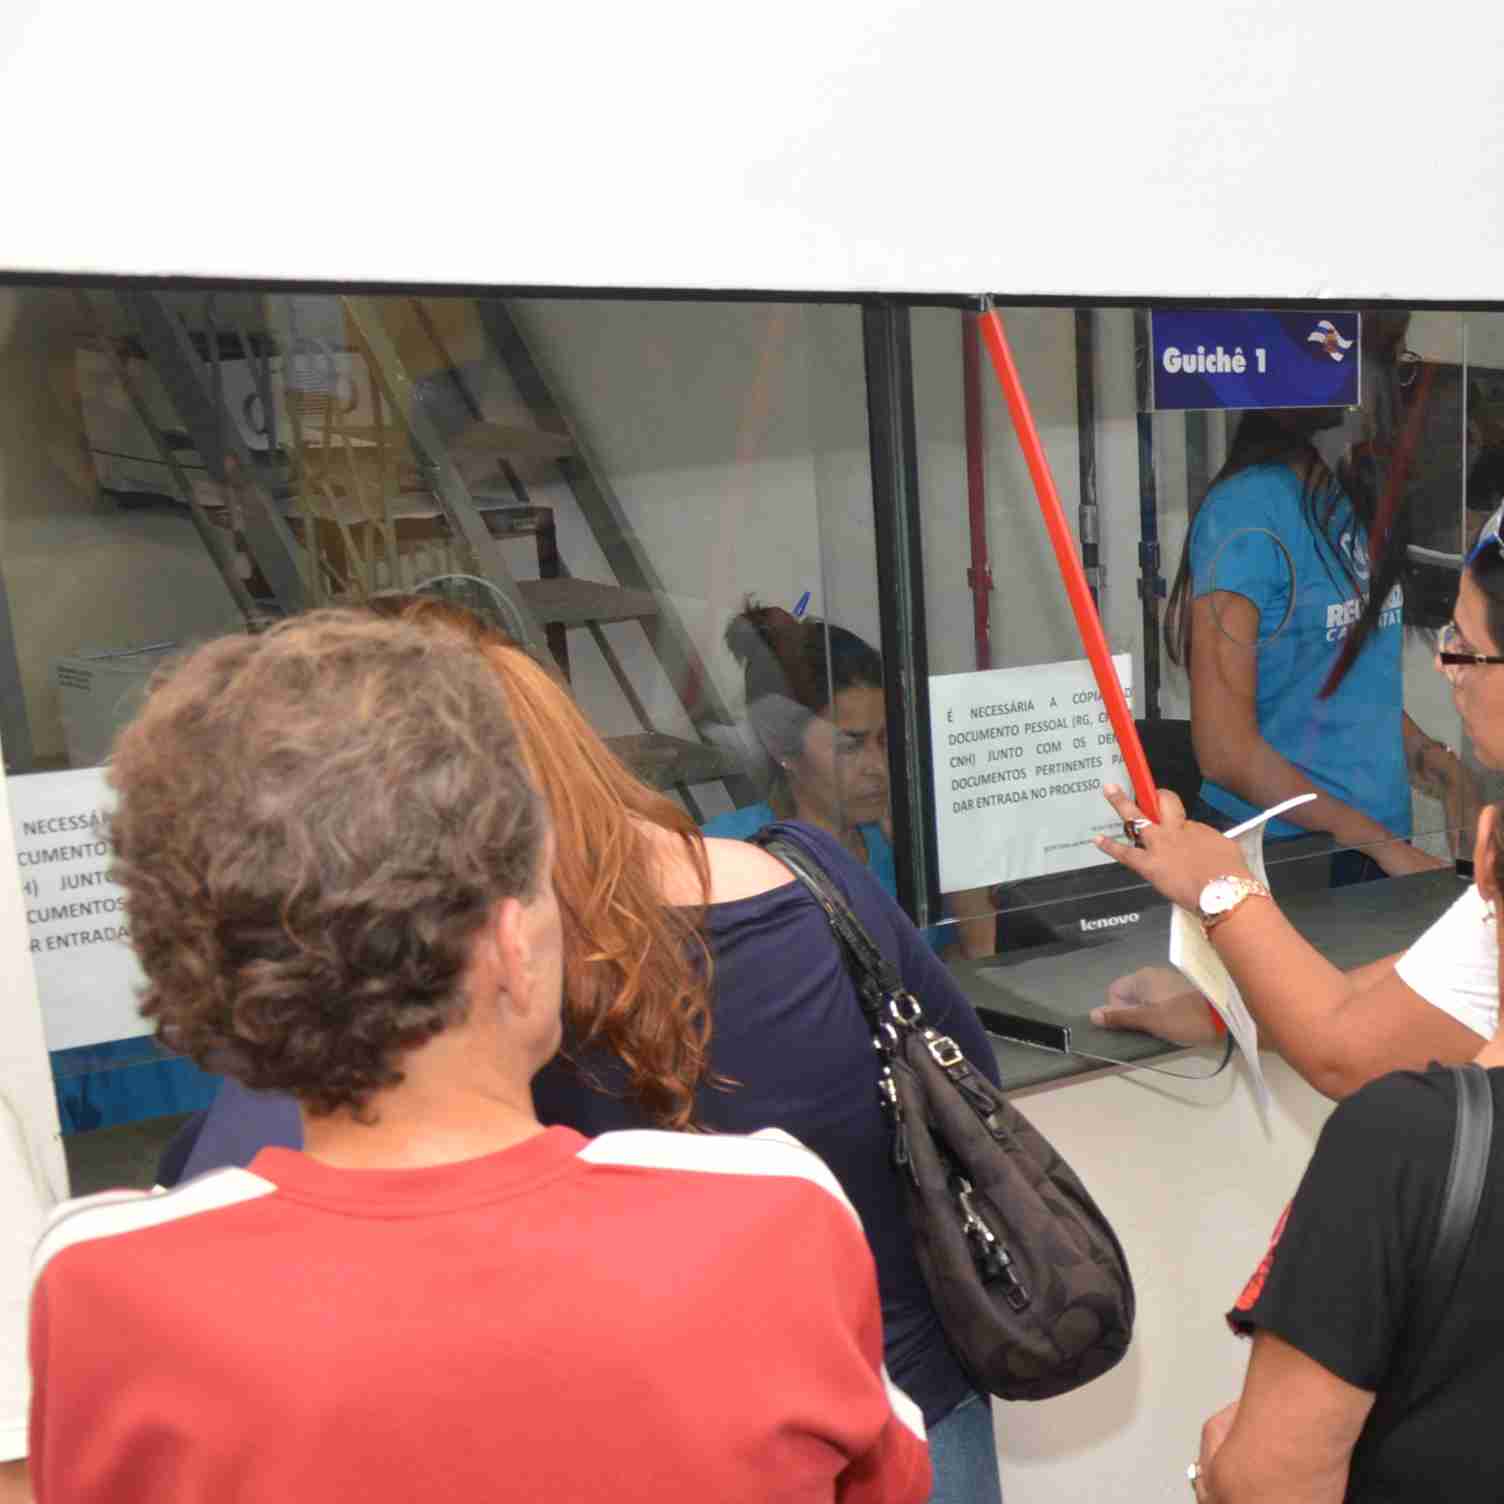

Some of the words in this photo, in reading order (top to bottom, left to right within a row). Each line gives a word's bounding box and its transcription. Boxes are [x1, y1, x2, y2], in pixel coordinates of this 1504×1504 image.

[1162, 345, 1247, 374] Guichê
[1255, 348, 1266, 373] 1
[947, 708, 953, 722] É
[970, 699, 1035, 719] NECESSÁRIA
[1050, 697, 1057, 707] A
[949, 725, 1020, 746] DOCUMENTO
[1024, 716, 1068, 735] PESSOAL
[987, 746, 1023, 762] JUNTO
[1036, 741, 1062, 755] COM
[1073, 735, 1087, 749] OS
[952, 768, 1027, 791] DOCUMENTOS
[1035, 756, 1103, 777] PERTINENTES
[952, 798, 975, 814] DAR
[976, 791, 1029, 809] ENTRADA
[1030, 786, 1048, 801] NO
[1080, 912, 1140, 931] lenovo
